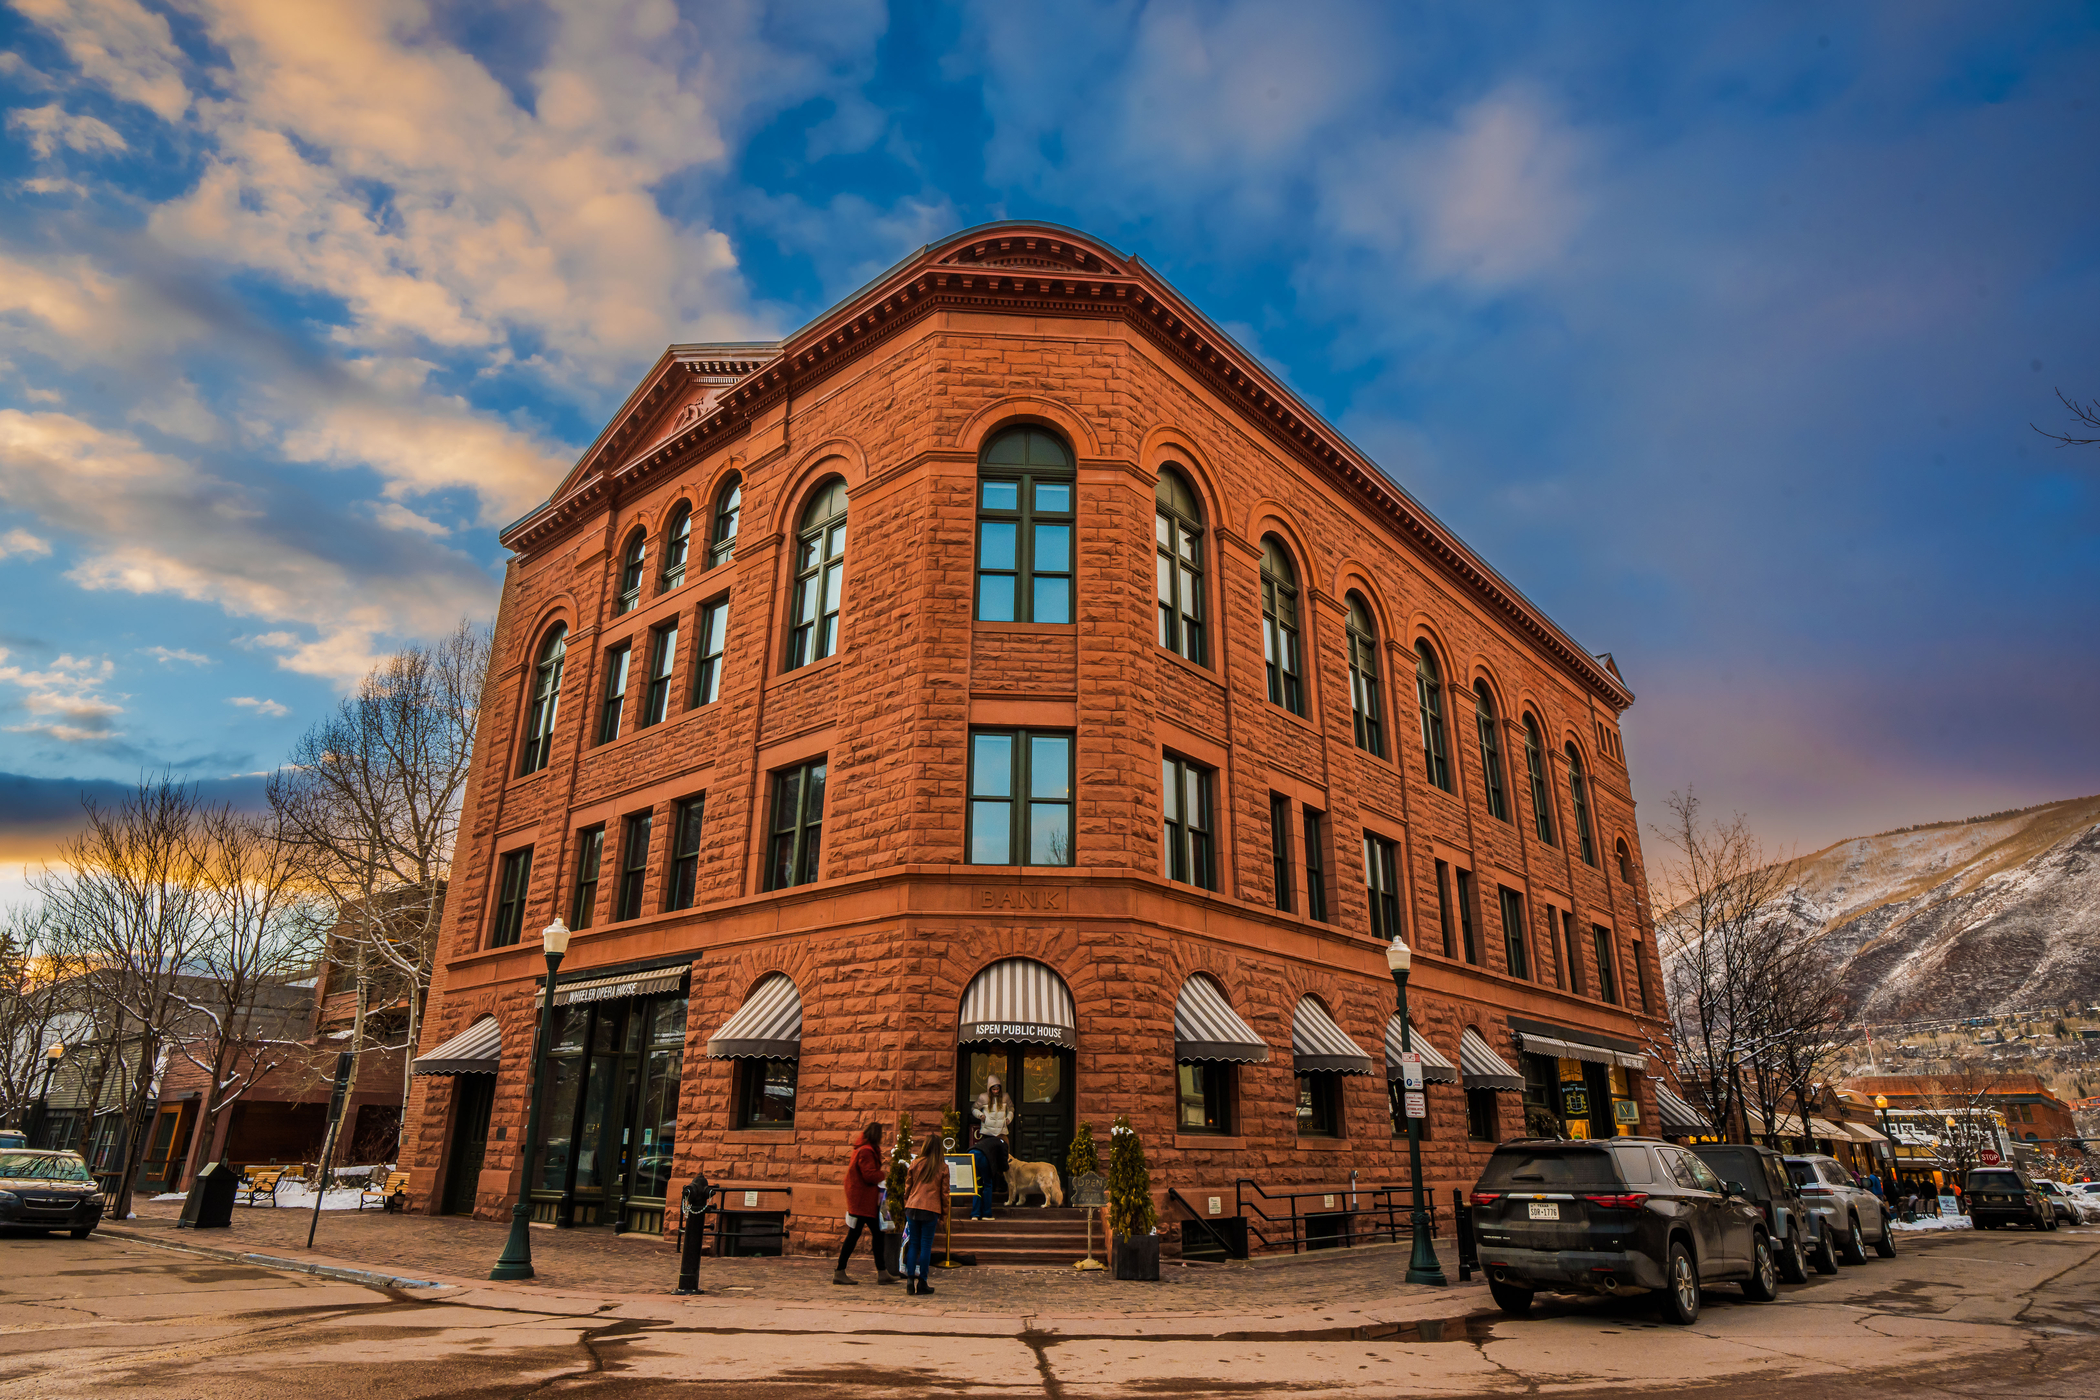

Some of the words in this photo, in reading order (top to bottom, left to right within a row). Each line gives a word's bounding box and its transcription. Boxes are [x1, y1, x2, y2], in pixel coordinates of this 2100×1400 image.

[981, 890, 1060, 909] BANK
[568, 988, 596, 1003] WHEELER
[616, 982, 638, 997] HOUSE
[975, 1024, 1001, 1035] ASPEN
[1002, 1024, 1036, 1036] PUBLIC
[1037, 1026, 1062, 1039] HOUSE
[1620, 1104, 1631, 1115] V
[1981, 1153, 1999, 1161] STOP
[1077, 1179, 1104, 1188] OPEN
